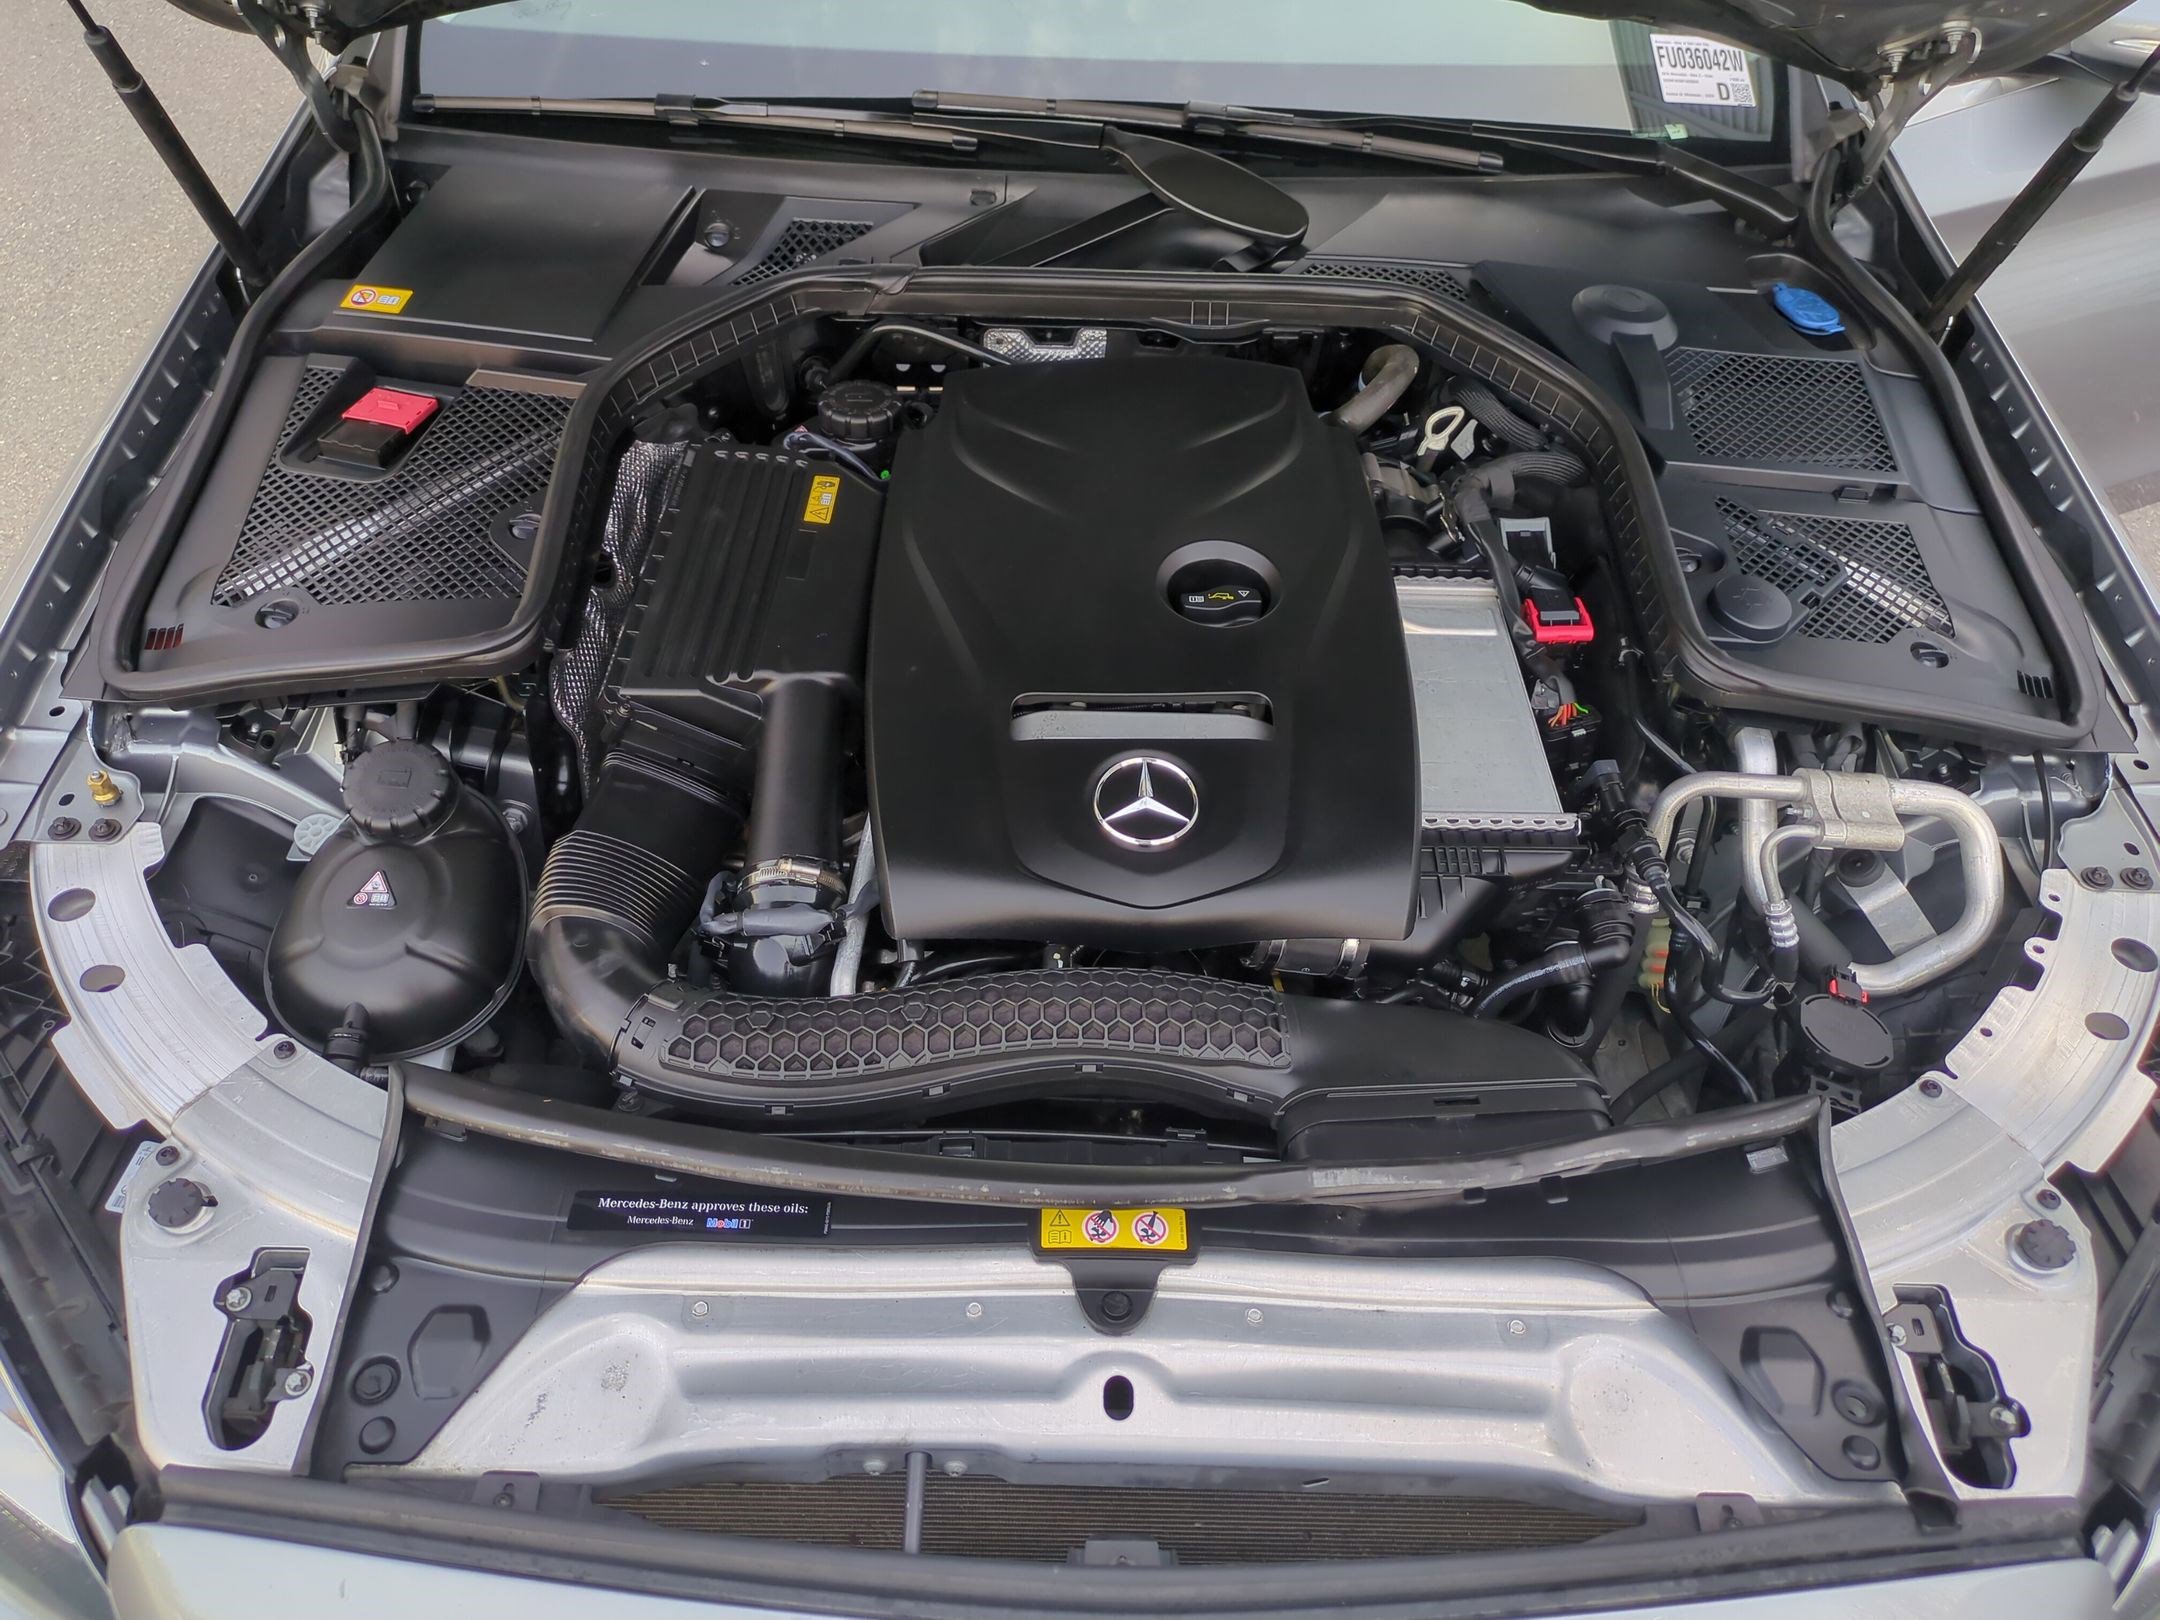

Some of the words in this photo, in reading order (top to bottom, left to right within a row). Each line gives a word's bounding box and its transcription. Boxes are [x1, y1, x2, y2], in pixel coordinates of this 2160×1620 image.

[1656, 46, 1743, 72] FU036042W
[1717, 82, 1730, 100] D
[598, 1198, 689, 1209] Mercedes-Benz
[691, 1201, 745, 1213] approves
[748, 1202, 781, 1213] these
[783, 1203, 809, 1214] oils:
[627, 1215, 694, 1226] Mercedes-Benz
[706, 1217, 738, 1229] Mobil
